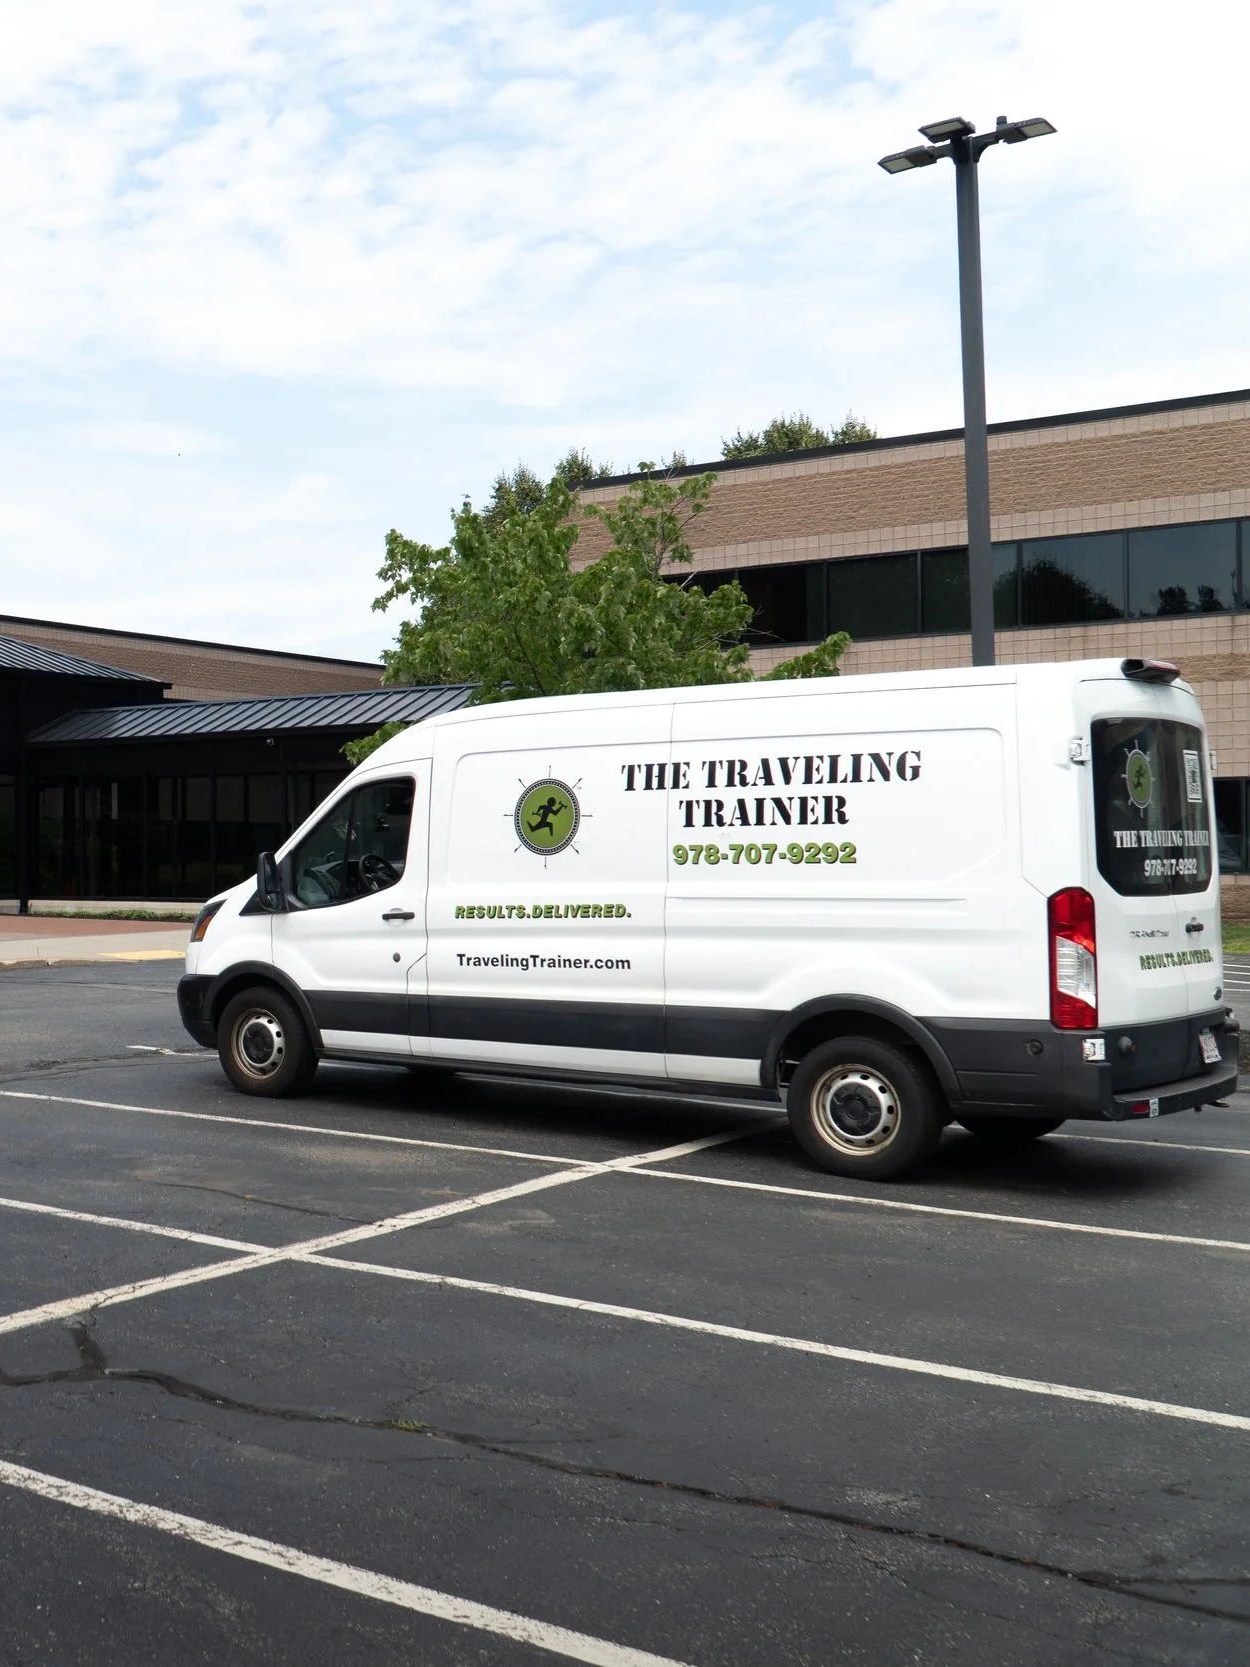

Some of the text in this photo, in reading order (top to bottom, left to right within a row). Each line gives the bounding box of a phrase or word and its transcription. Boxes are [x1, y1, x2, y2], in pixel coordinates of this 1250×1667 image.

[621, 750, 922, 791] THE TRAVELING
[678, 795, 850, 828] TRAINER
[1113, 830, 1139, 848] THE
[1139, 830, 1183, 848] TRAVELING
[672, 842, 857, 865] 978-707-9292
[454, 903, 632, 919] RESULTS.DELIVERED.
[456, 953, 631, 971] TravelingTrainer.com
